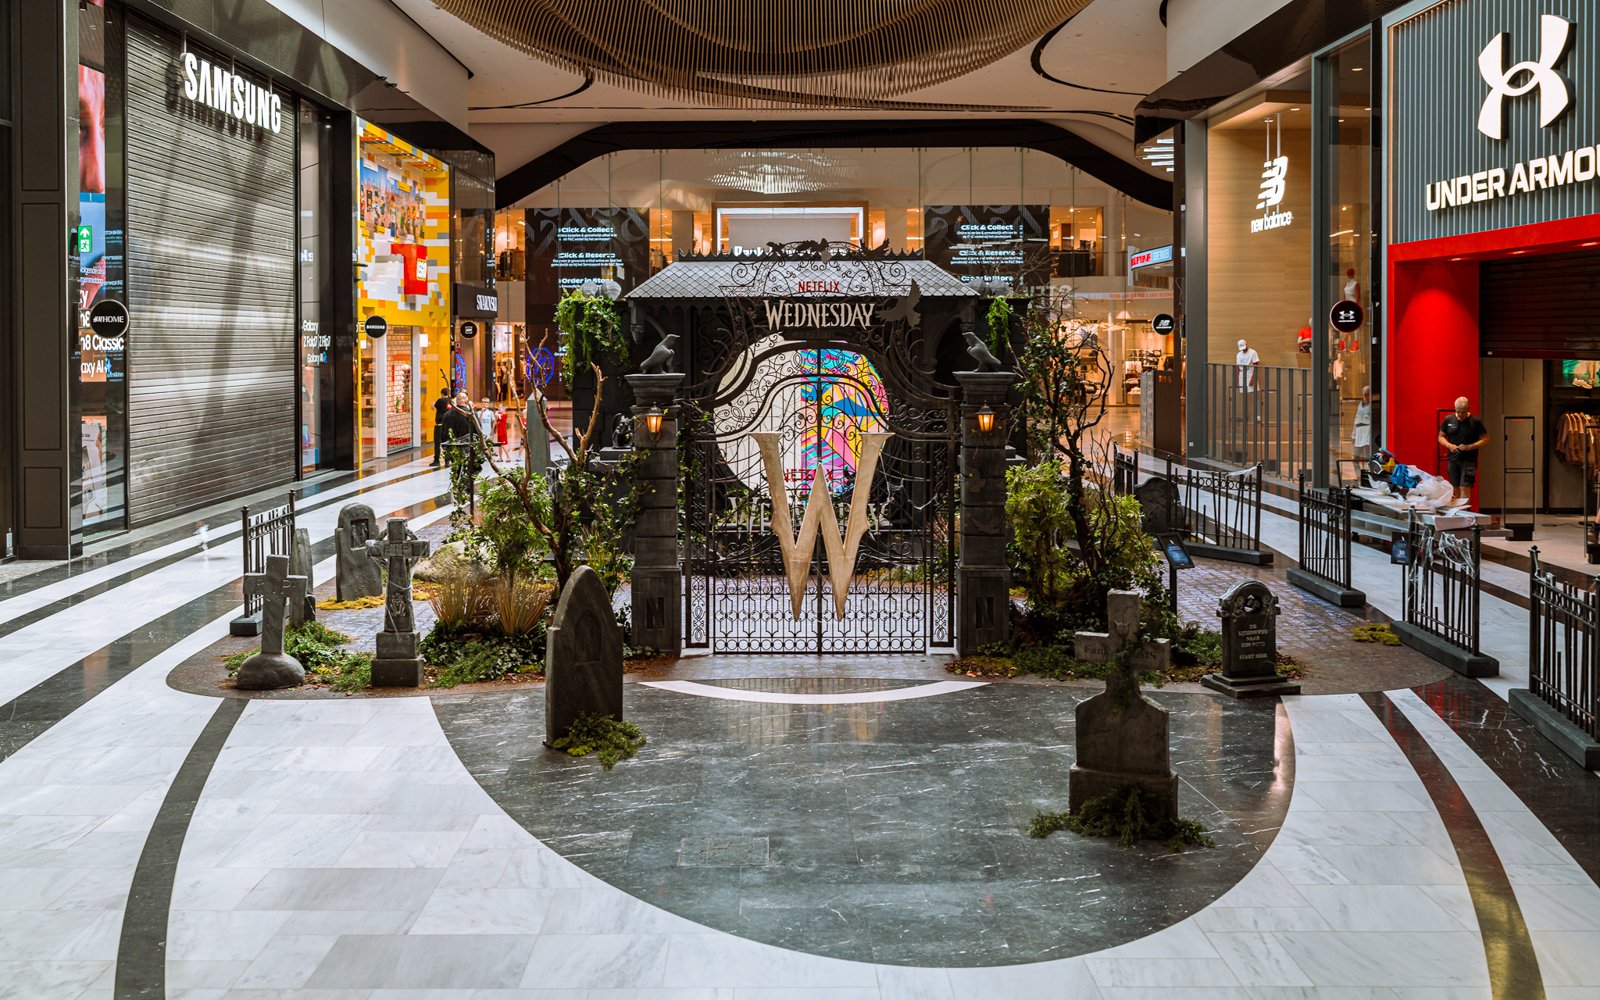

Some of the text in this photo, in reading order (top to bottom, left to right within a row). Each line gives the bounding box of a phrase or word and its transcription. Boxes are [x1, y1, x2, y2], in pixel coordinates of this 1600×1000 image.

[184, 52, 281, 134] SAMSUNG
[1426, 167, 1505, 211] UNDER
[1250, 211, 1292, 234] new balance
[798, 281, 840, 293] NETFLIX
[102, 315, 124, 323] HOME
[763, 299, 875, 331] WEDNESDAY
[92, 334, 125, 351] Classic
[747, 432, 896, 622] W
[646, 596, 662, 625] N
[975, 596, 994, 625] N
